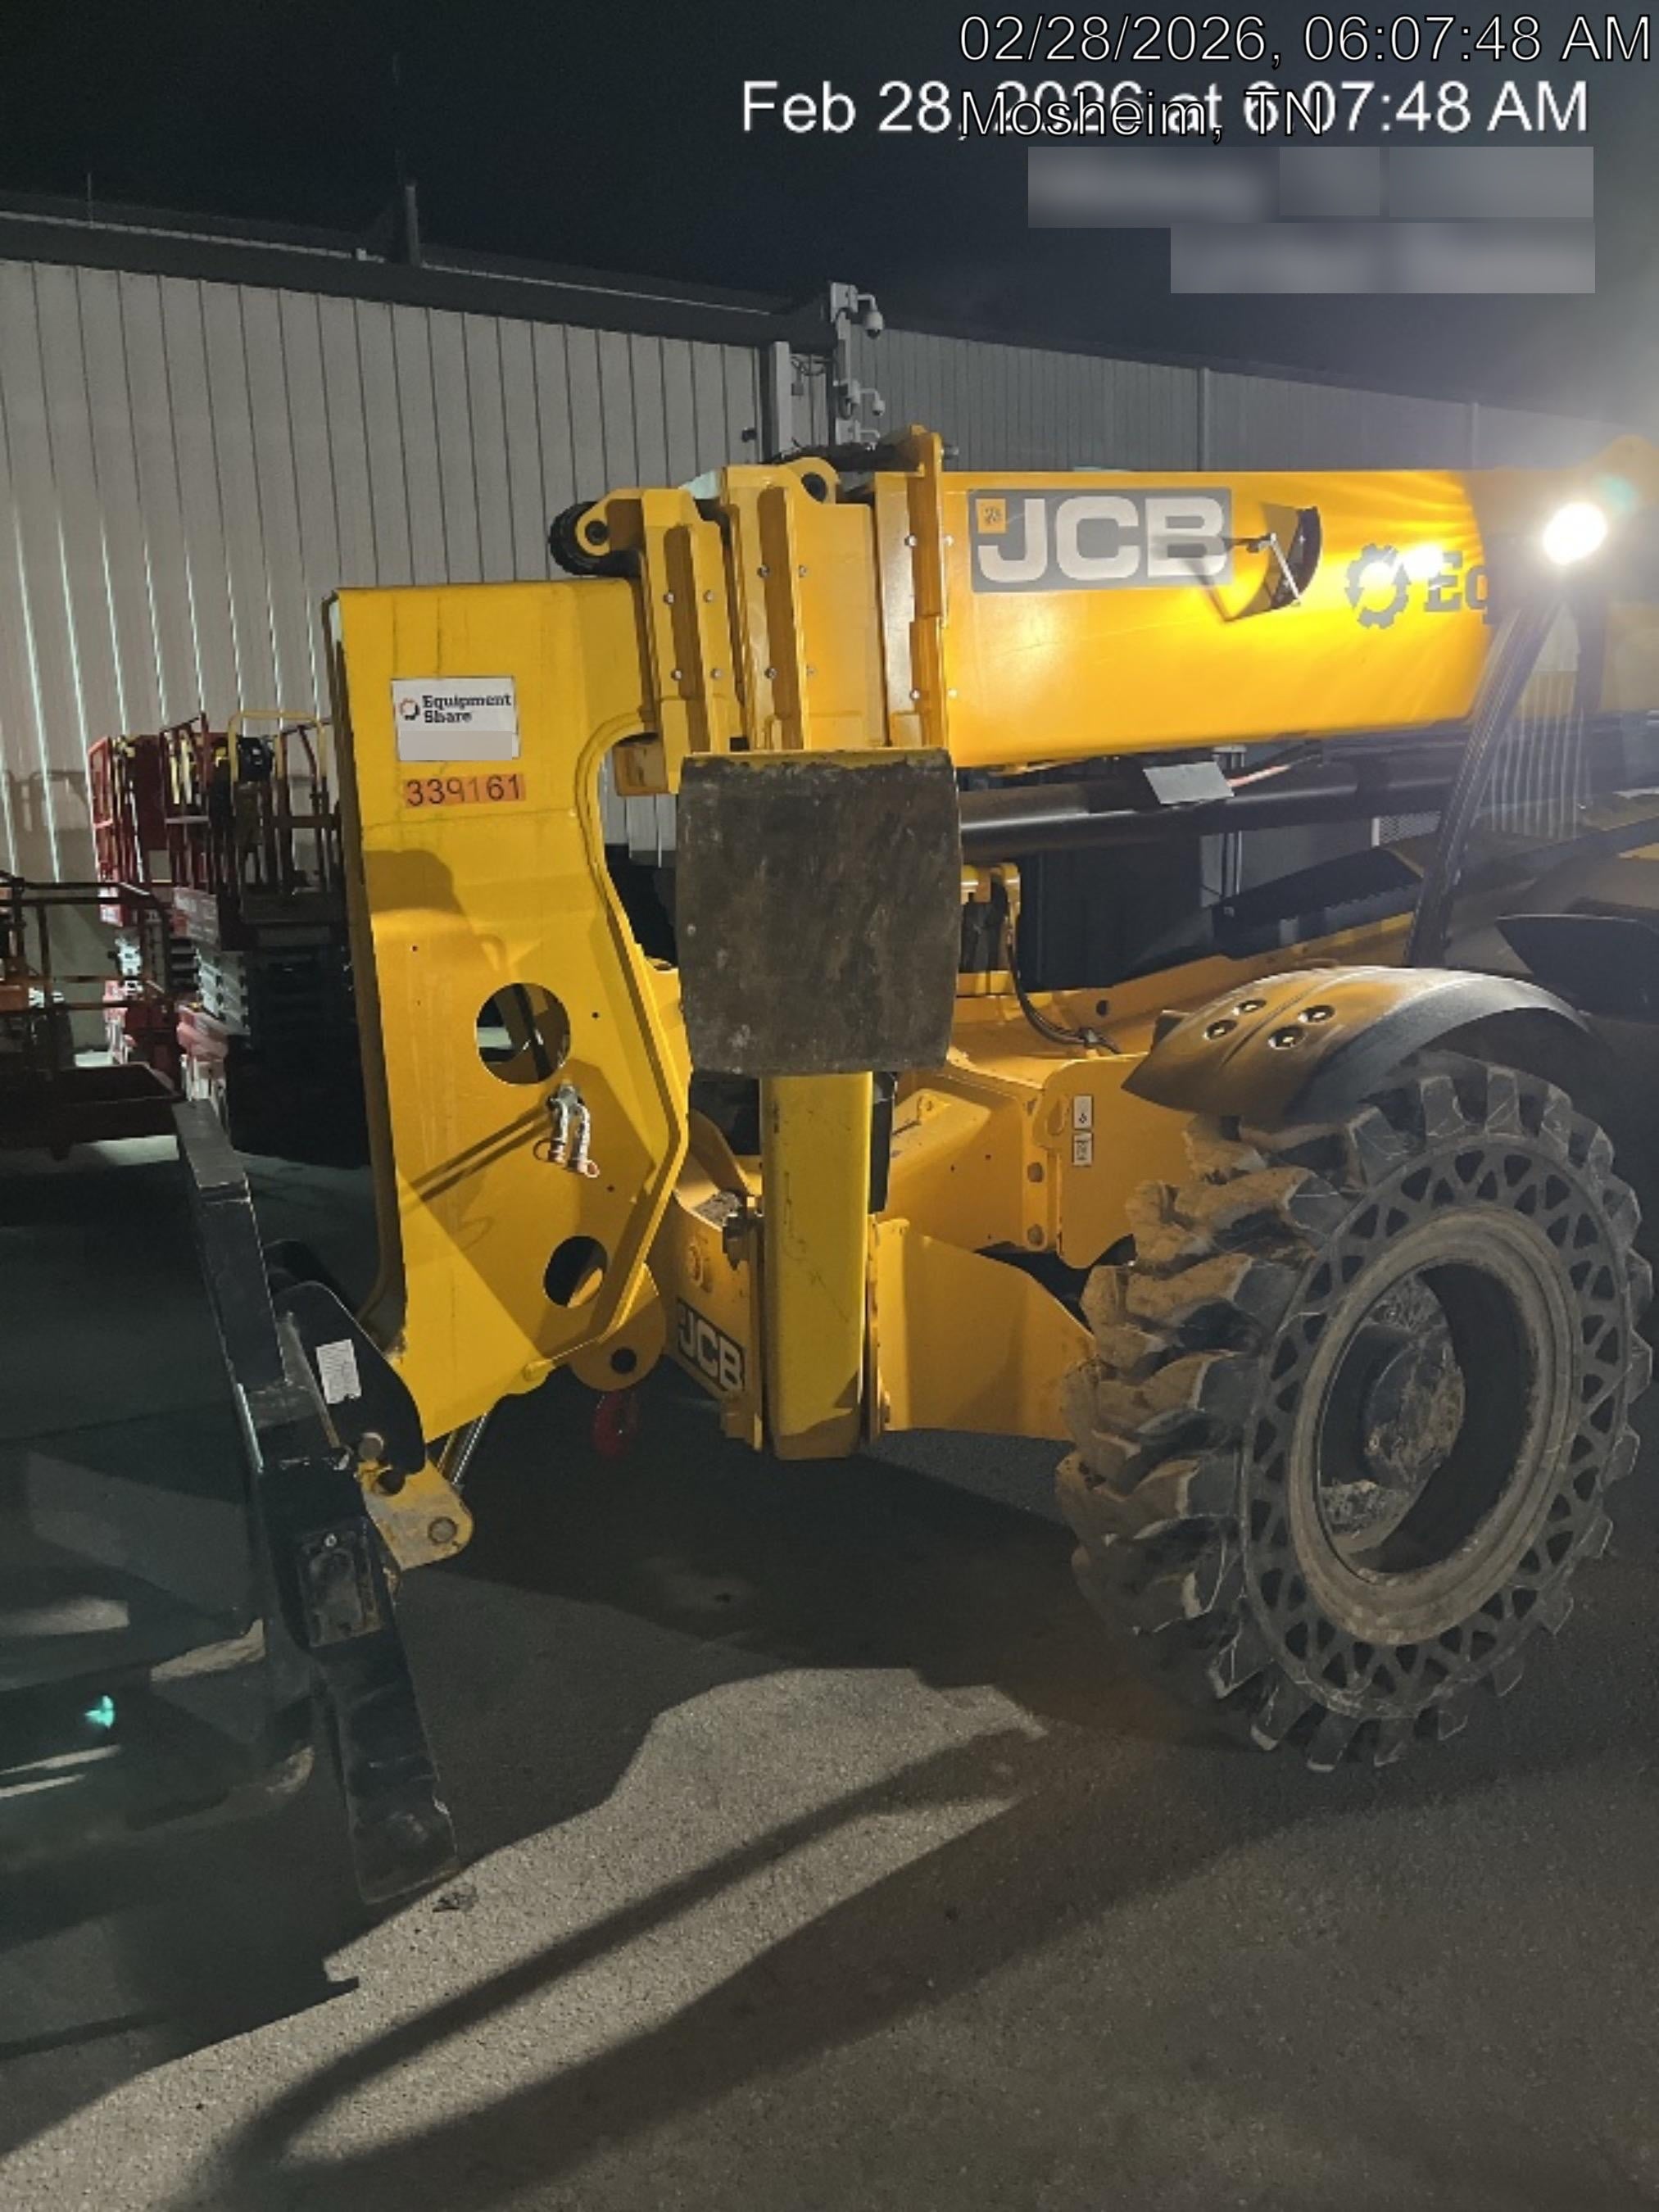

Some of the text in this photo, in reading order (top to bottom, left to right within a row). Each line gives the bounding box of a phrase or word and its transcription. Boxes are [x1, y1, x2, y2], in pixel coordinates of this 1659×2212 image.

[977, 496, 1226, 582] JCB
[422, 695, 512, 710] Equipment
[424, 709, 473, 723] Share
[406, 773, 519, 806] 339161
[678, 1303, 744, 1391] JCB
